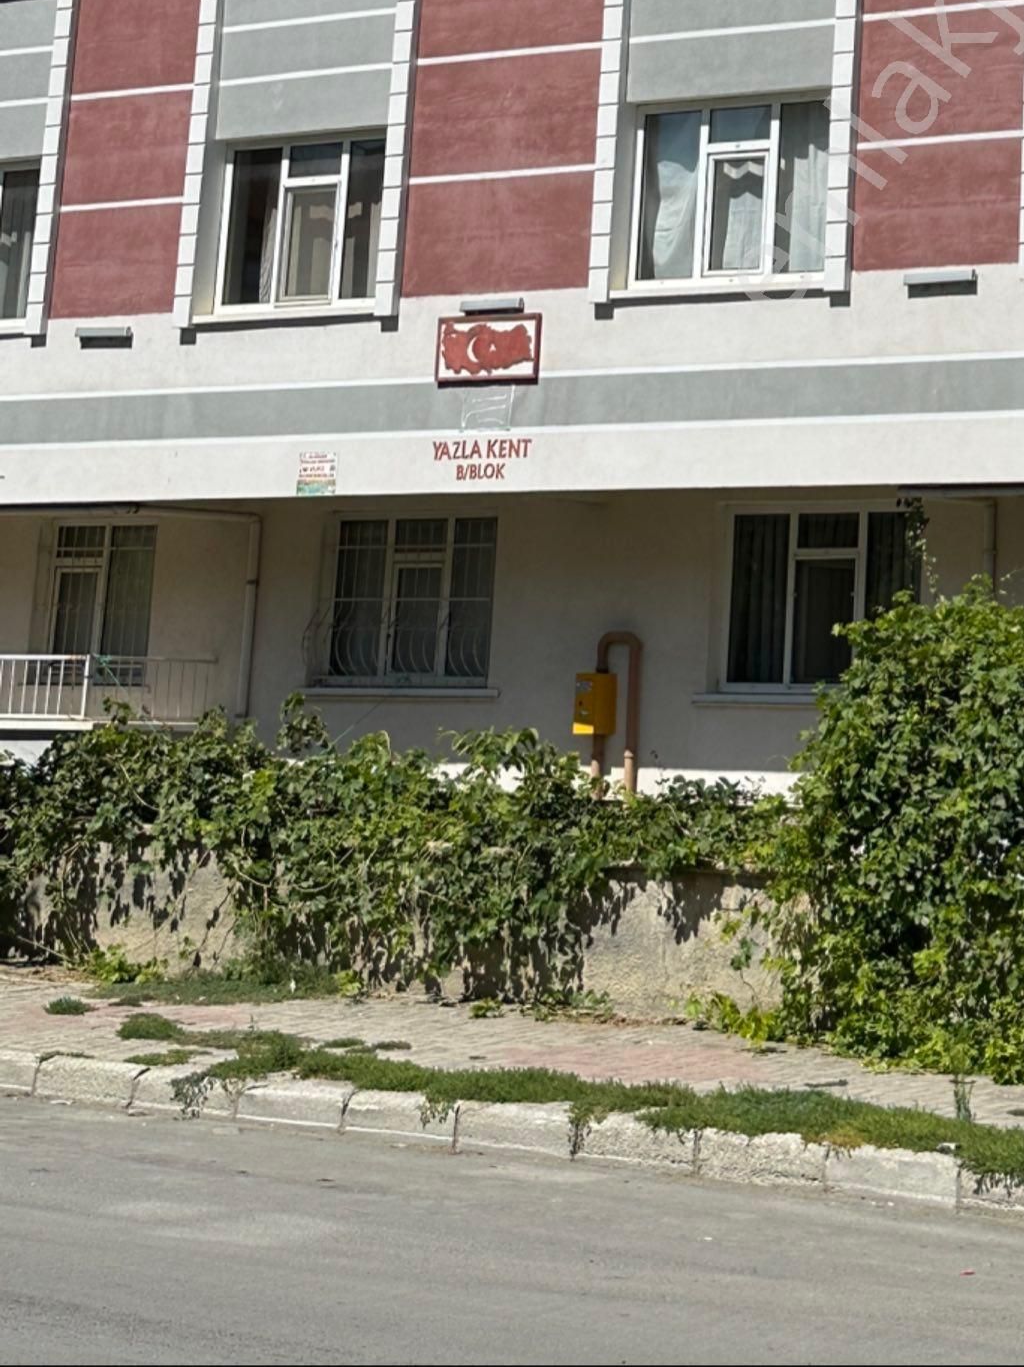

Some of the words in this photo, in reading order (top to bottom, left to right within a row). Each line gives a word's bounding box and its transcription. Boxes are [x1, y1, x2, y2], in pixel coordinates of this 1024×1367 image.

[432, 440, 482, 461] YAZLA
[486, 438, 532, 459] KENT
[456, 463, 506, 481] B/BLOK
